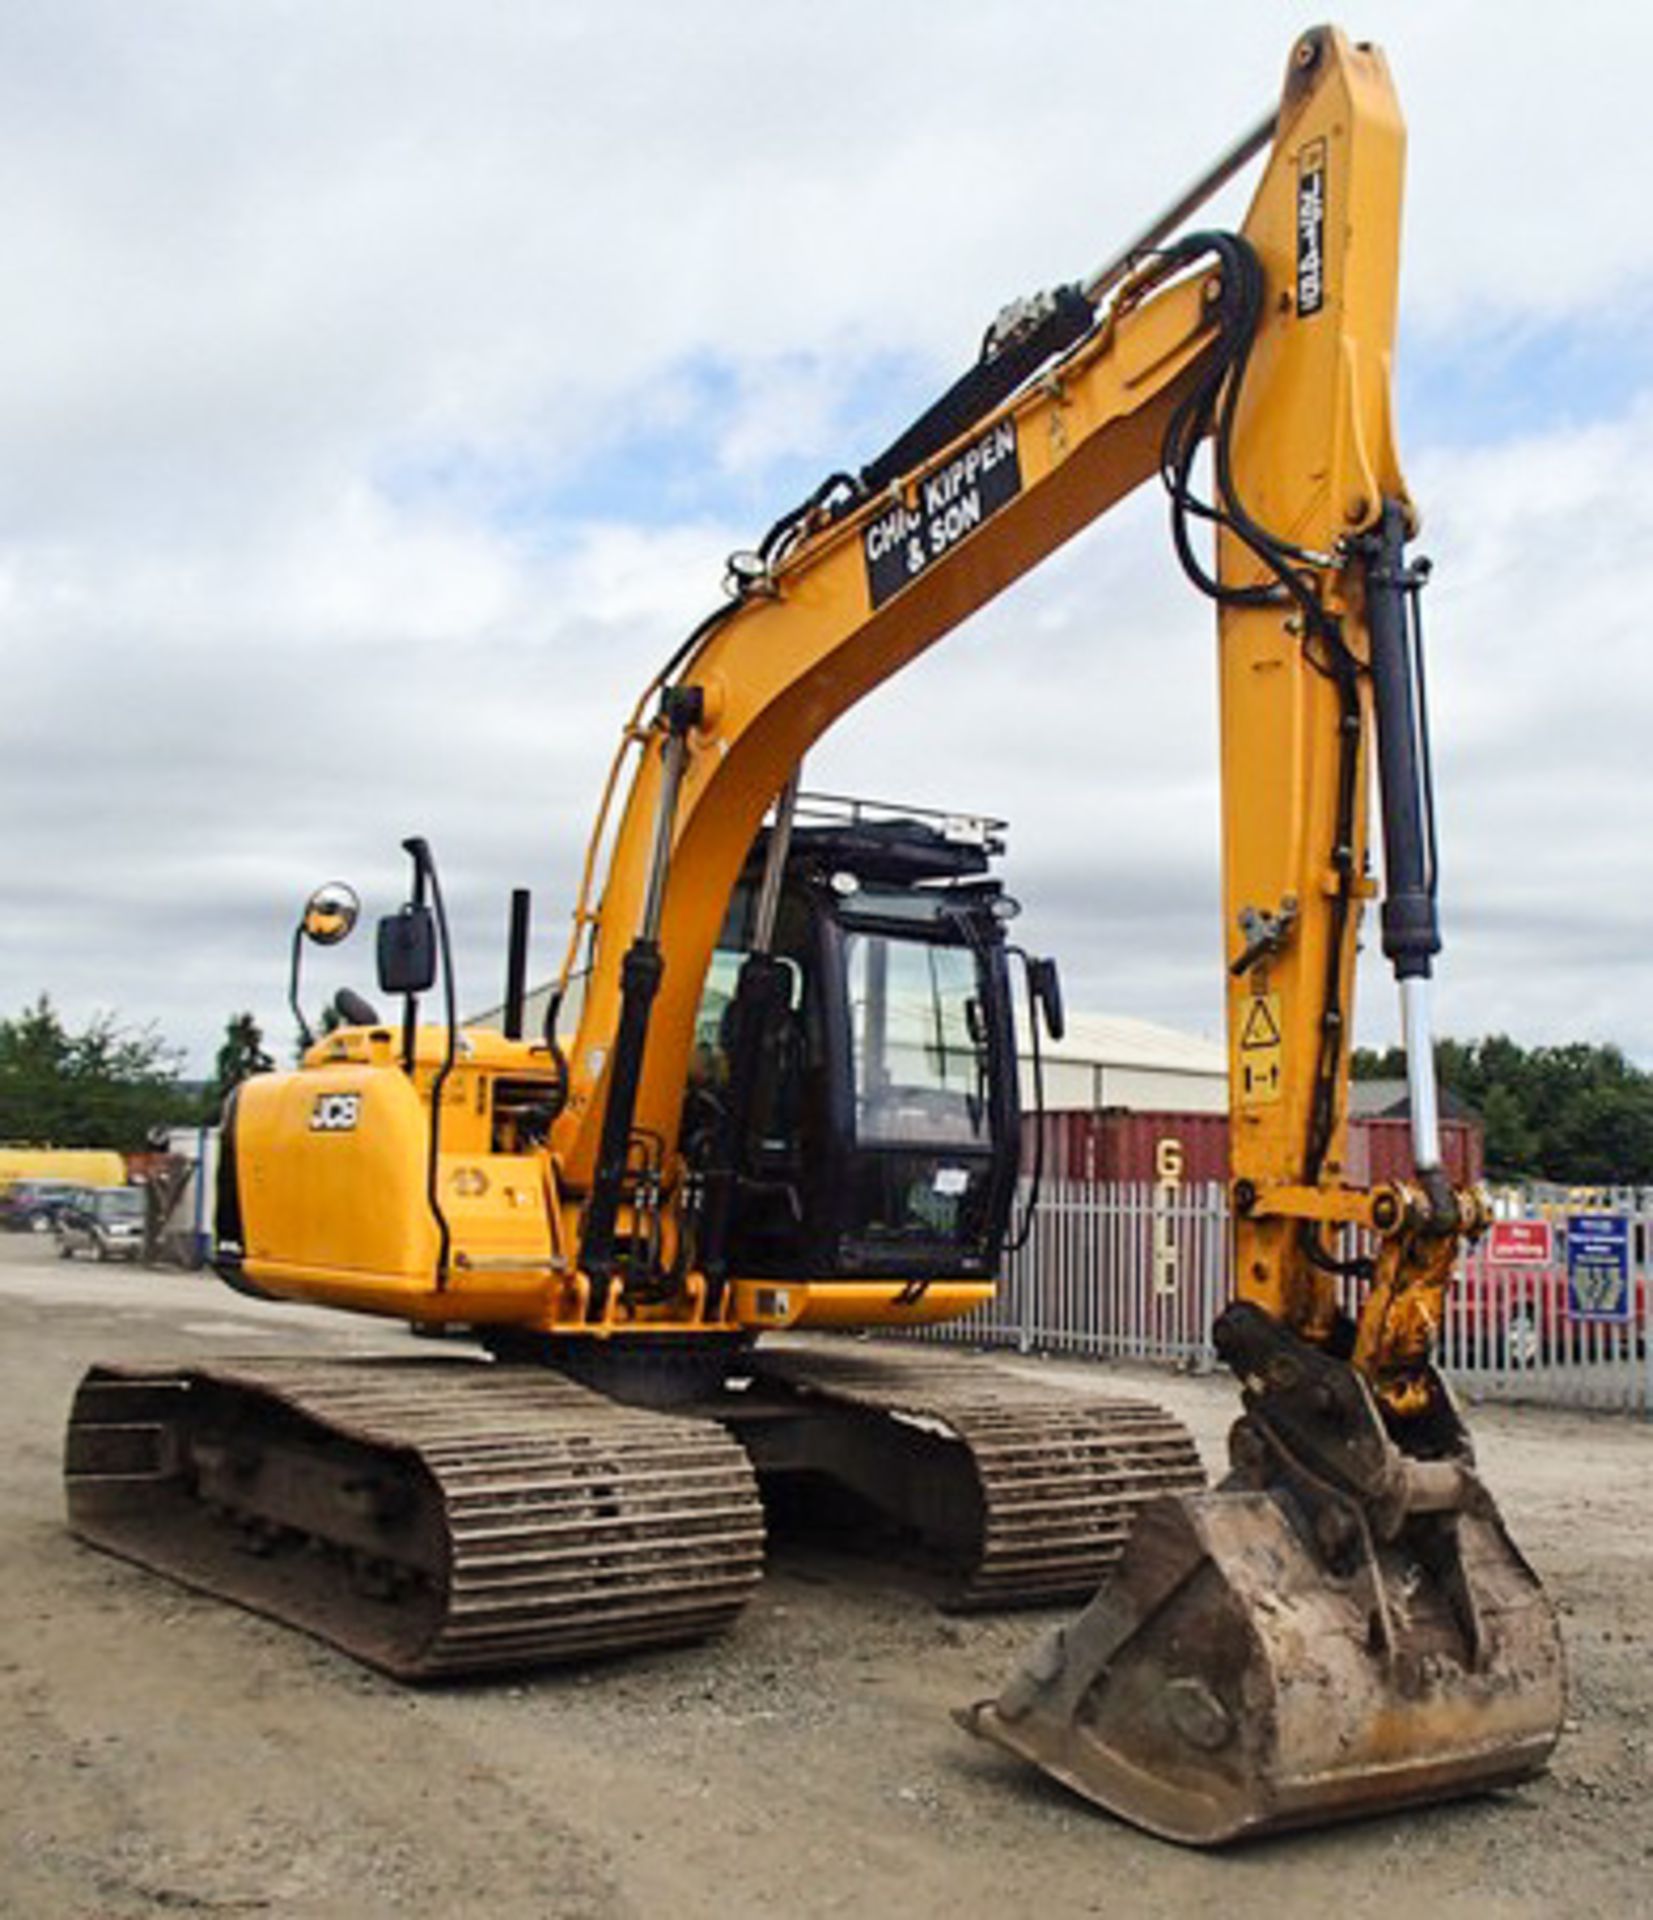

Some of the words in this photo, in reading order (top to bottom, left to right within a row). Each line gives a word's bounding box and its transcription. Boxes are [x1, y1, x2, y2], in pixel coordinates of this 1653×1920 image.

[923, 420, 1015, 516] KIPPEN
[907, 537, 925, 573] &
[930, 488, 981, 554] SON
[312, 1096, 357, 1128] JCB
